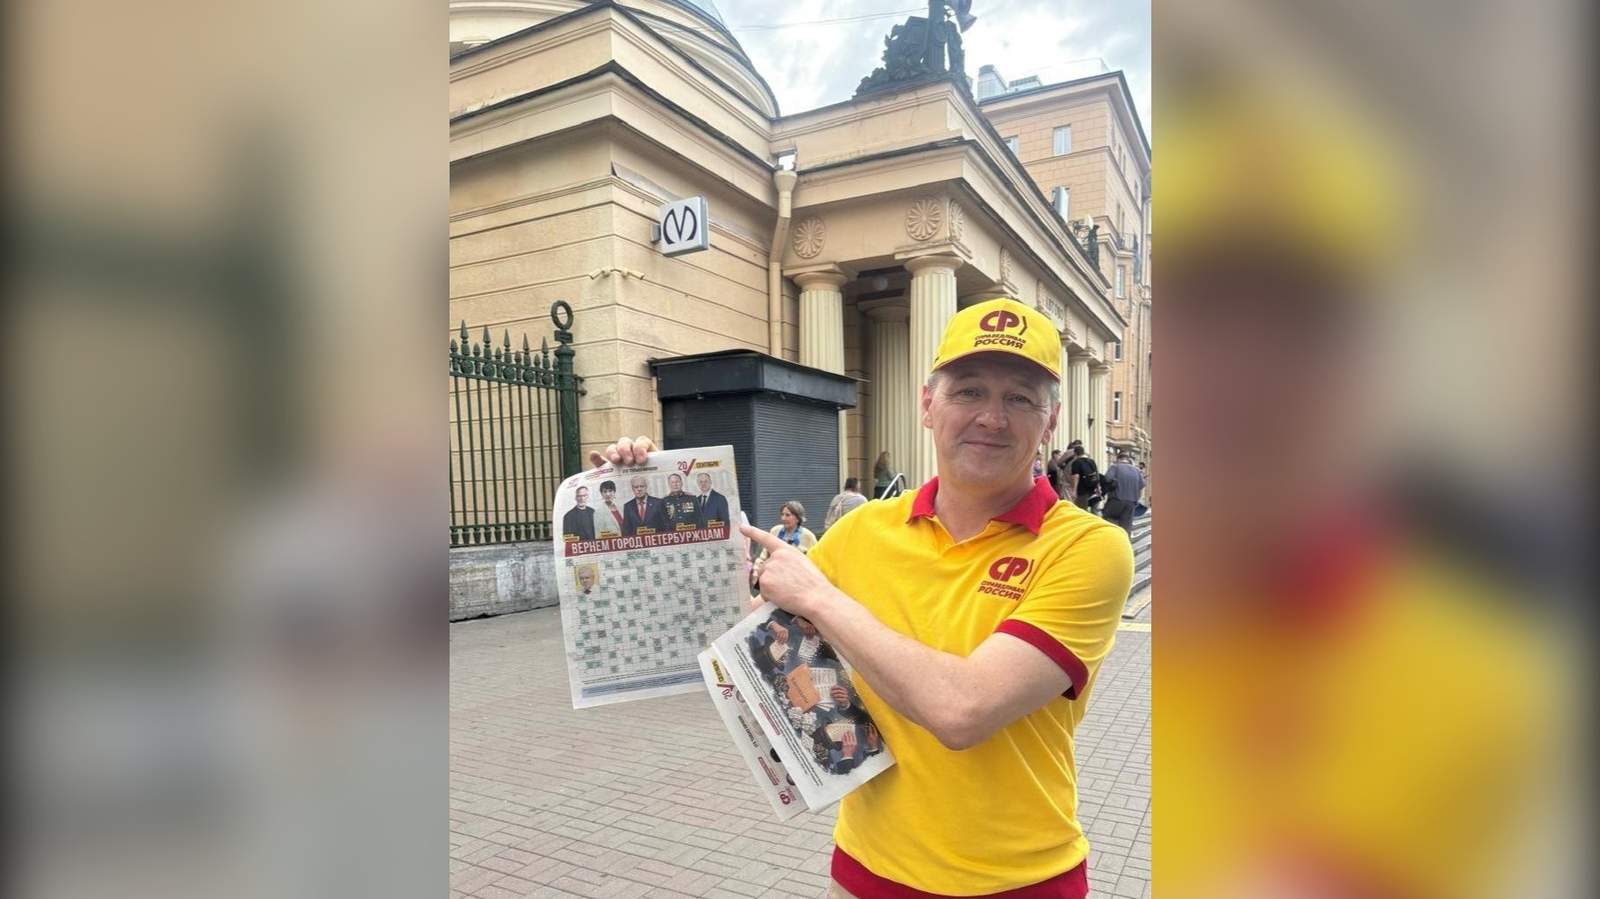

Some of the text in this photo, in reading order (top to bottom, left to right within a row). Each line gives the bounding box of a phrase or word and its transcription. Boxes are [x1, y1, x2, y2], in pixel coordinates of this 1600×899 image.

[974, 338, 1024, 349] РОССИЯ
[677, 460, 688, 471] 20
[571, 541, 610, 554] ВЕРНЕМ
[611, 536, 643, 550] ГОРОД
[645, 527, 724, 546] ПЕТЕРБУРЖЦАМ!
[977, 585, 1022, 601] РОССИЯ
